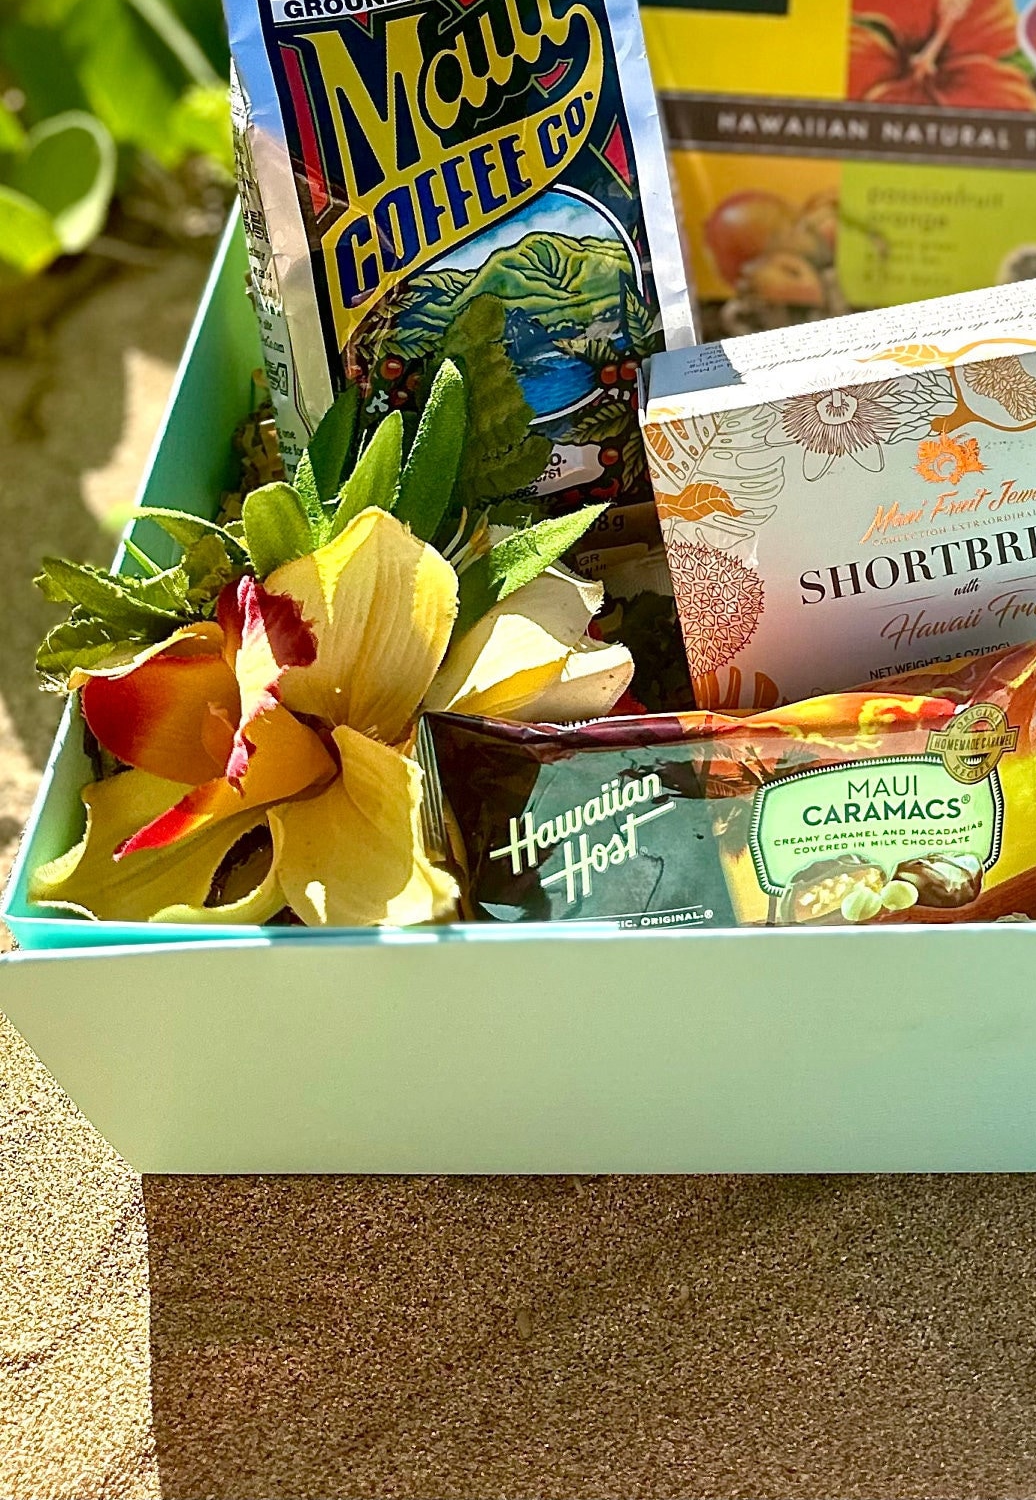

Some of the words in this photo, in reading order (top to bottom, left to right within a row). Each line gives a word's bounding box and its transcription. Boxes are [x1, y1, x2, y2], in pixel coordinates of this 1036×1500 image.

[717, 110, 870, 142] HAWAIIAN
[882, 120, 1011, 152] NATURAL
[333, 130, 535, 310] COFFEE
[859, 500, 928, 545] Maui
[930, 488, 992, 524] Fruit
[953, 577, 980, 597] with
[880, 608, 982, 651] Hawaii
[869, 666, 893, 681] NET
[847, 775, 918, 800] MAUI
[489, 773, 663, 877] Hawaiian
[802, 797, 962, 827] CARAMACS
[773, 834, 820, 847] CREAMY
[824, 829, 878, 841] CARAMEL
[882, 828, 906, 837] AND
[911, 820, 984, 836] MACADAMIAS
[793, 842, 848, 855] COVERED
[870, 838, 897, 847] MILK
[902, 835, 971, 846] CHOCOLATE
[541, 800, 676, 905] Host
